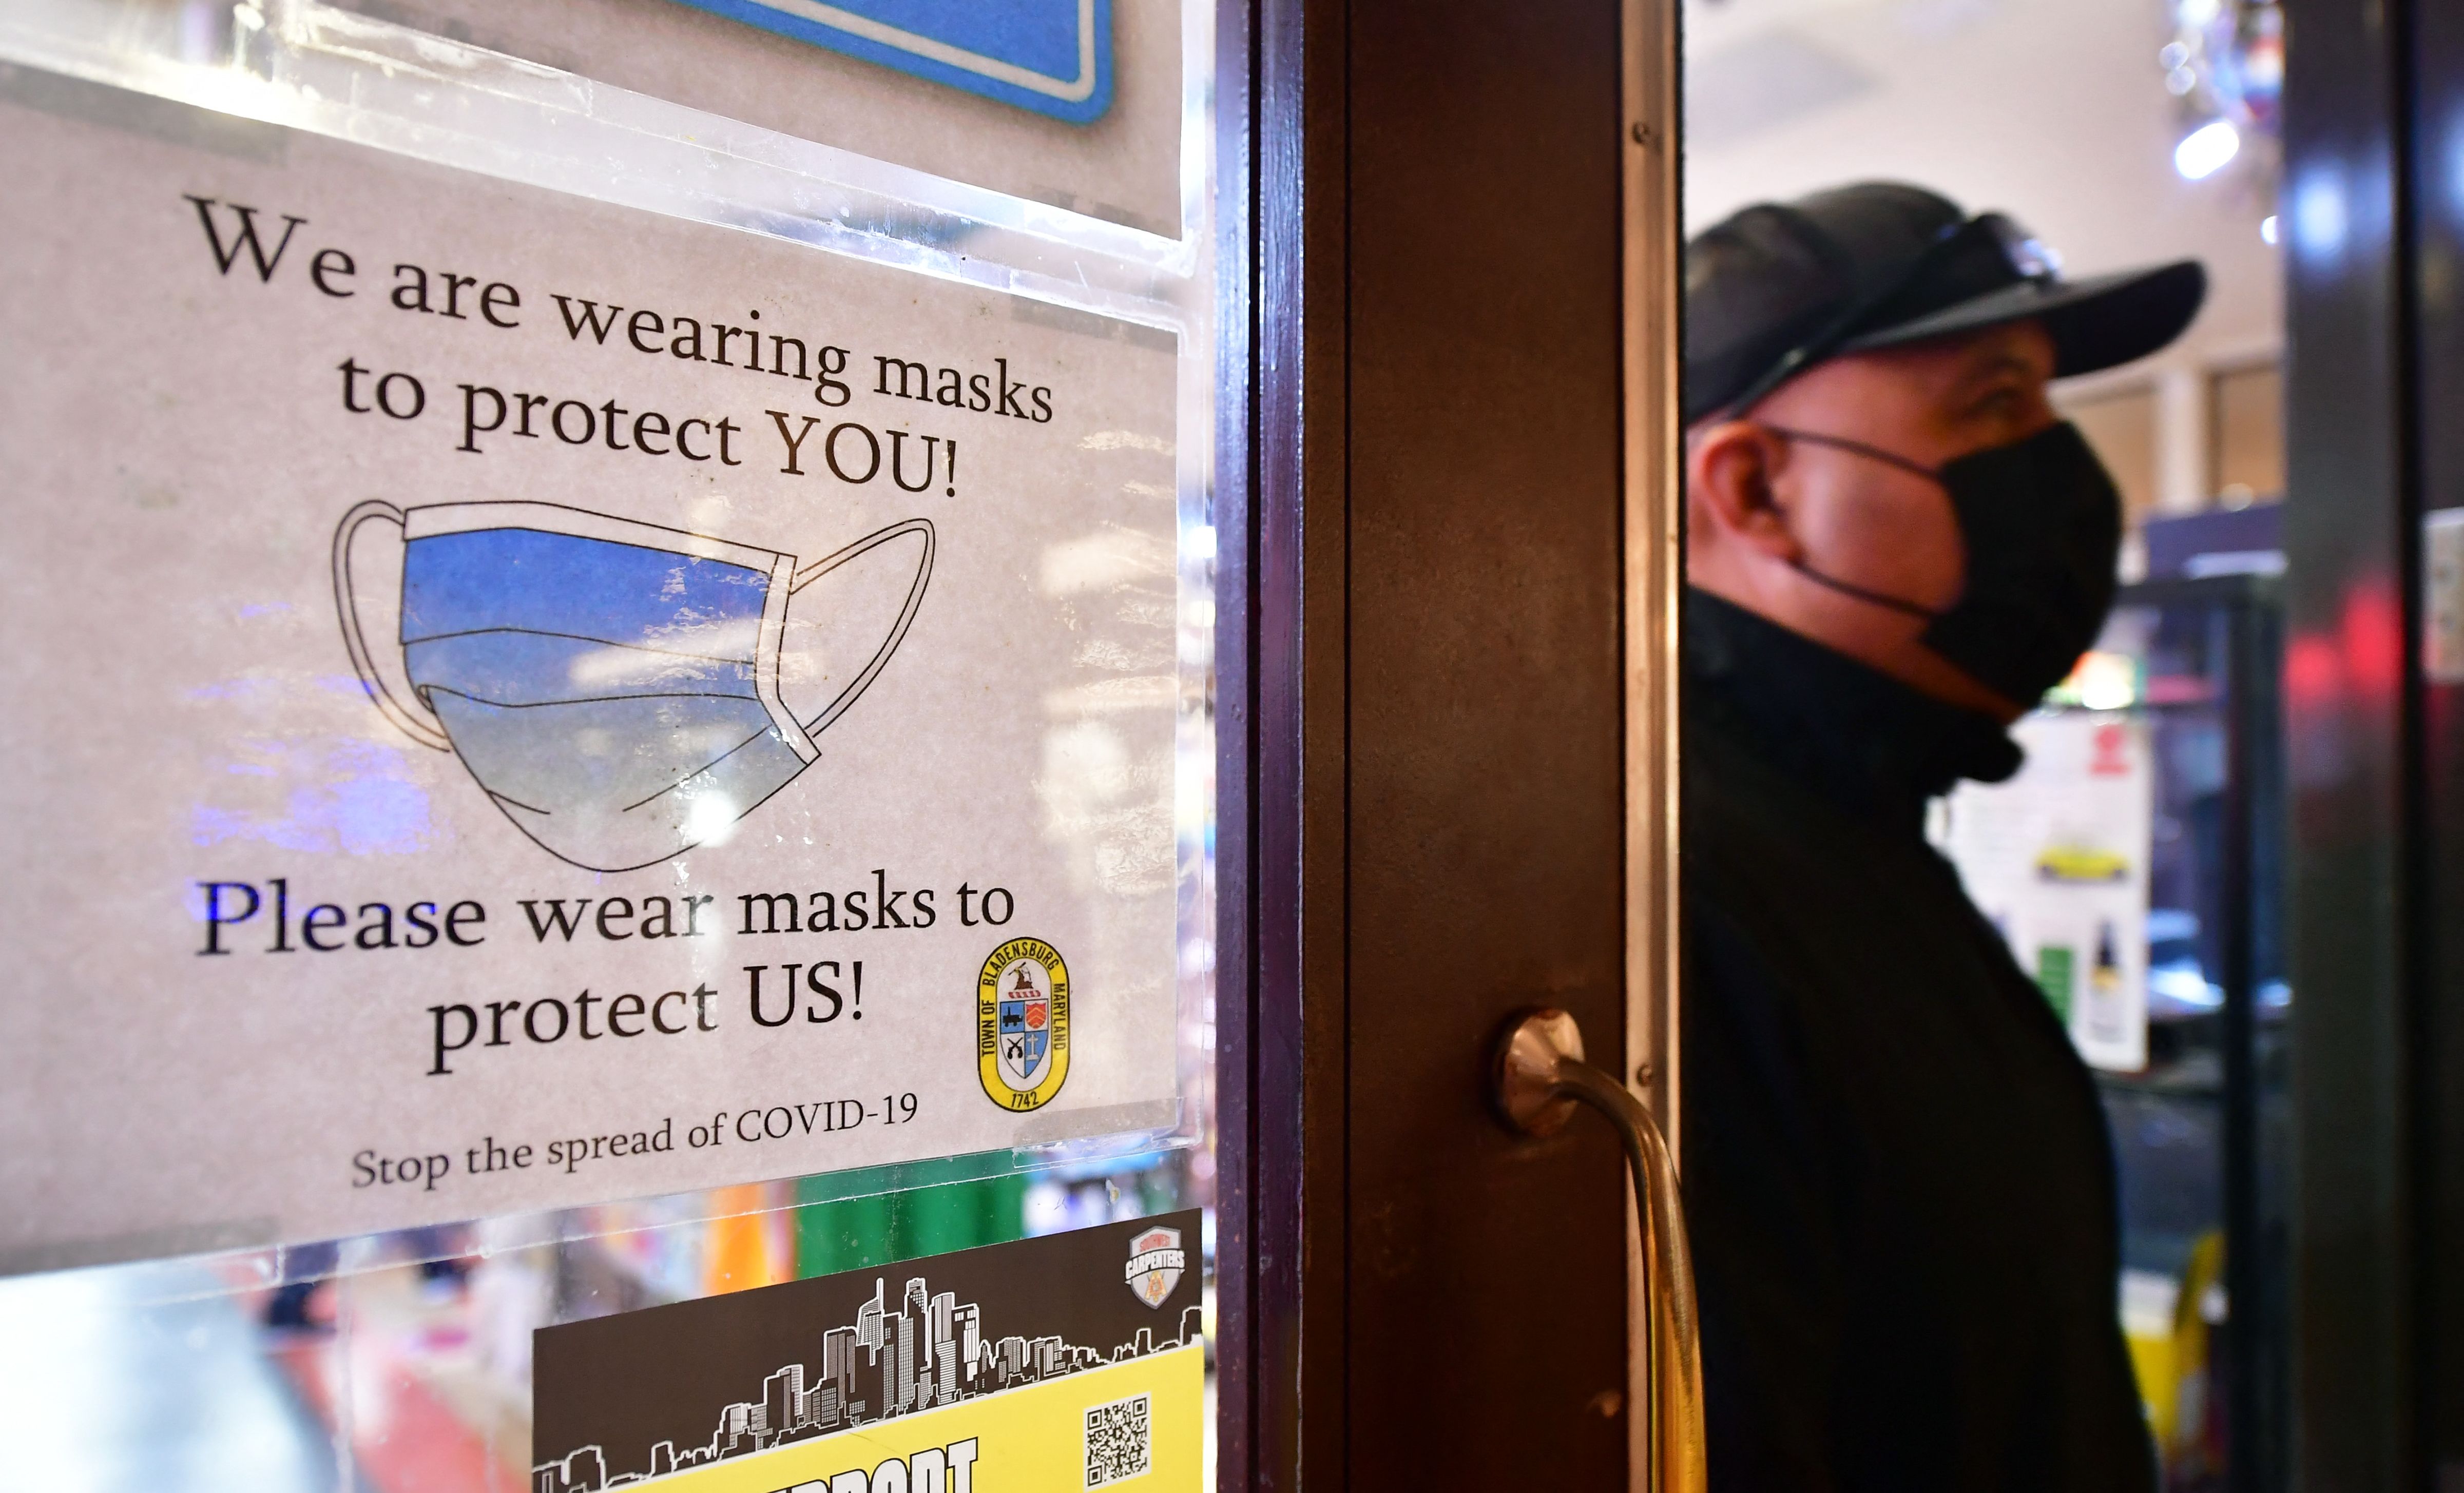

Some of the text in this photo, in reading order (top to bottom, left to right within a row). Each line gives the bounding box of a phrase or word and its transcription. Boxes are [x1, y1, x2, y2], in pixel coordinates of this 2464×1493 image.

[183, 195, 1053, 423] We are wearing masks
[337, 358, 956, 498] to protect YOU!
[196, 868, 1014, 956] Please wear masks to
[426, 961, 862, 1076] protect US!
[981, 942, 1067, 1057] TOWN OF BLADENSBURG MARYLAND
[353, 1093, 918, 1191] Stop the spread of COVID-19
[1011, 1091, 1039, 1108] 1742
[1125, 1250, 1185, 1279] CARPENTERS
